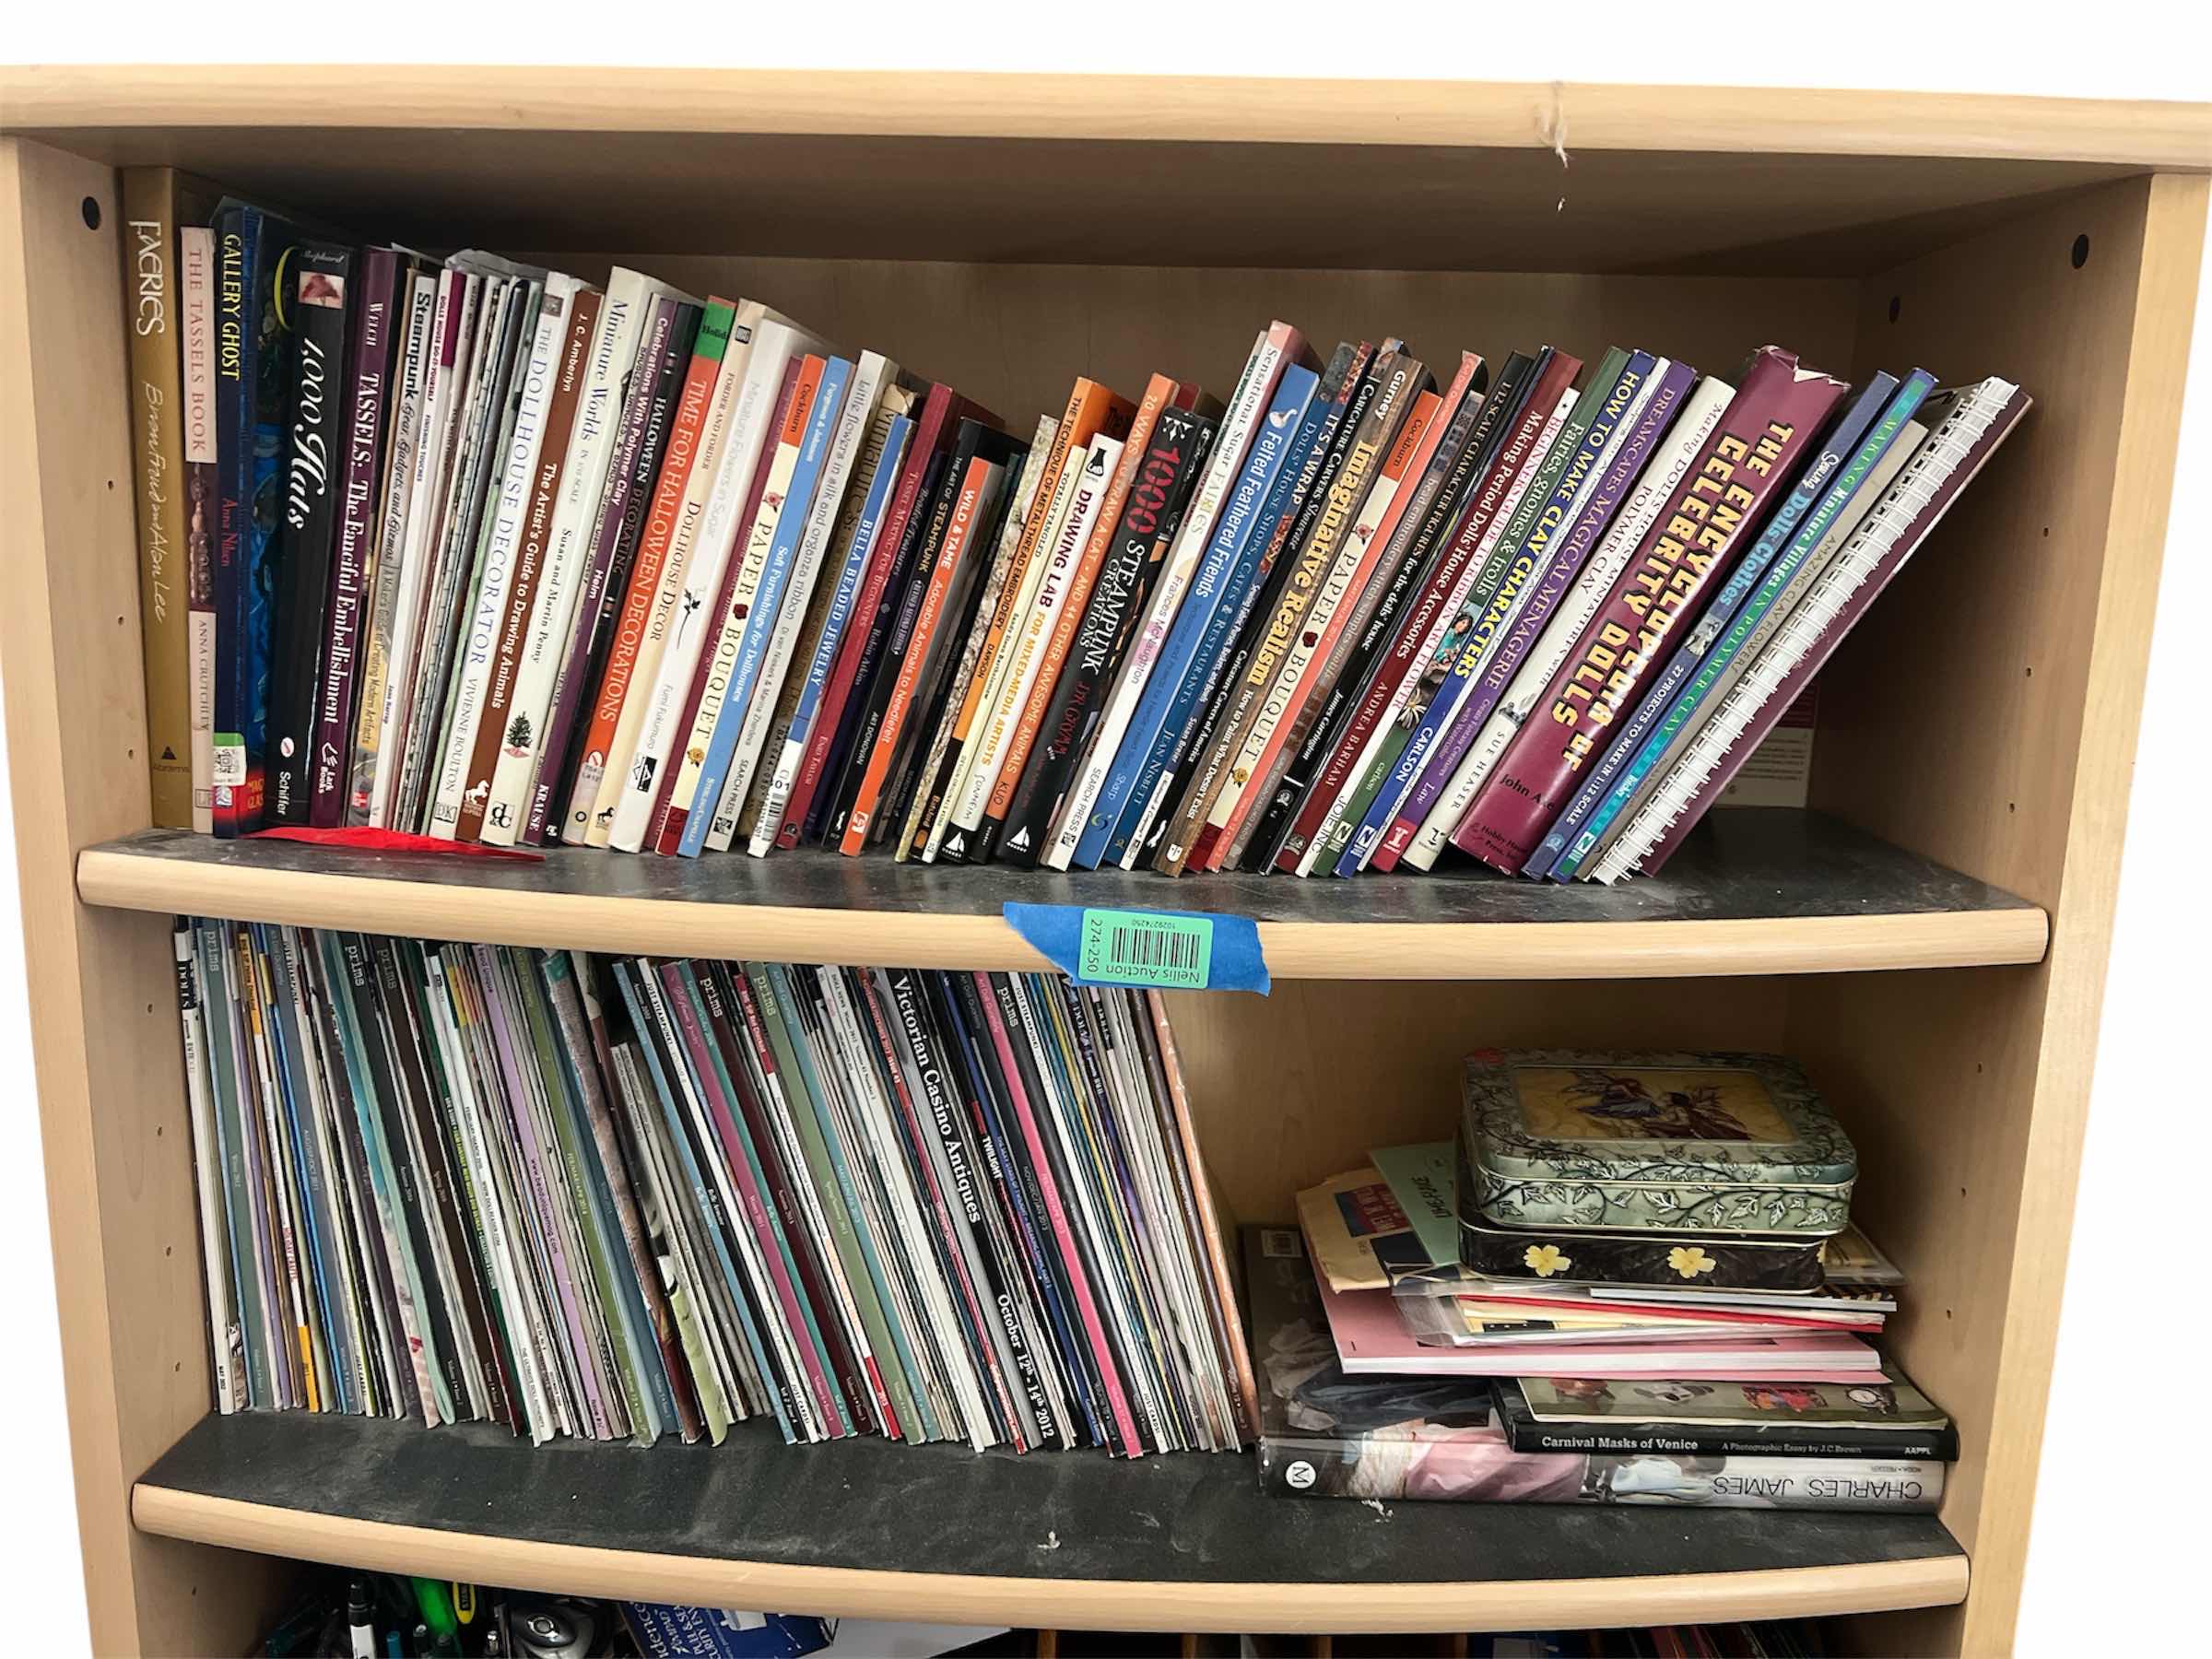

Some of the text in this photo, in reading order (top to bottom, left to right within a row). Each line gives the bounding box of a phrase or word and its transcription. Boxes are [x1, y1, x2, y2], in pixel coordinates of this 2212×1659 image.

[220, 233, 241, 380] GALLERY GHOST
[188, 249, 206, 451] THE TASSELS BOOK
[561, 312, 588, 393] J. C. Amberlyn
[580, 298, 628, 442] Miniature Worlds
[610, 316, 667, 506] Celebrations With Polymer Clay
[1372, 367, 1406, 420] Gurney
[415, 414, 430, 482] FINISHING TOUCHES
[710, 412, 724, 438] AND
[1392, 418, 1423, 468] Cockburn
[1288, 413, 1339, 505] IT'S A WRAP
[221, 497, 237, 529] Anna
[908, 487, 930, 525] Beaded
[1049, 472, 1070, 513] TOTALLY
[1126, 447, 1180, 535] 1000
[1194, 429, 1283, 600] Felted Feathered Friends
[1416, 477, 1438, 506] bead
[1475, 419, 1584, 598] Fairies, gnomes & trolls
[324, 371, 380, 724] TASSELS: The Fanciful Embellishment
[598, 379, 707, 722] TIME FOR HALLOWEEN DECORATIONS
[1033, 512, 1055, 559] TANGLED
[1380, 504, 1423, 570] embroidery
[1394, 408, 1545, 661] Making Period Dolls' House Accessories
[1453, 370, 1641, 679] HOW TO MAKE CLAY CHARACTERS
[1483, 386, 1676, 691] DREAMSCAPES MAGICAL MENAGERIE
[1579, 483, 1653, 594] POLYMER CLAY
[736, 522, 773, 597] PAPER
[890, 526, 916, 577] Treasures
[1244, 435, 1379, 689] Imaginative Realism
[489, 462, 557, 709] The Artist's Guide to Drawing Animals
[808, 518, 873, 687] BELLA BEADED JEWELRY
[1079, 559, 1118, 647] CREATIONS
[1082, 538, 1146, 676] STEAMPUNK
[1364, 571, 1387, 602] stitch
[1551, 435, 1748, 727] CELEBRITY DOLLS
[981, 488, 1093, 766] DRAWING LAB FOR MIXED-MEDIA ARTISTS
[1006, 612, 1019, 633] Sandy
[1339, 600, 1371, 645] samples
[692, 626, 741, 739] BOUQUET
[982, 653, 1004, 700] Bartholomew
[1170, 583, 1260, 763] Sewing Fabric Purses, Baskets, and Bowls Susan Breier
[1241, 552, 1357, 761] PAPER BOUQUET
[1366, 762, 1385, 791] carlson
[1394, 724, 1435, 783] CARLSON
[1452, 731, 1505, 809] SUE HEASER
[276, 771, 291, 814] Schiffer
[1067, 767, 1102, 833] SEARCH PRESS
[1416, 782, 1435, 805] Law
[1500, 773, 1530, 797] John
[204, 930, 219, 973] prims
[346, 945, 365, 987] prims
[1087, 919, 1103, 973] 274-250
[646, 982, 657, 998] JUST
[700, 977, 724, 1018] prims
[756, 975, 776, 1017] prims
[1014, 986, 1024, 1003] JUST
[1106, 964, 1200, 983] Nellis Auction
[997, 985, 1019, 1028] prims
[894, 976, 981, 1224] Victorian Casino Antiques
[982, 1135, 1003, 1181] TWILIGHT
[995, 1293, 1025, 1350] October
[791, 1383, 801, 1399] JUST
[1016, 1352, 1034, 1377] 12th
[1026, 1383, 1044, 1408] 14th
[1142, 1392, 1153, 1408] JUST
[1034, 1407, 1055, 1438] 2012
[1541, 1436, 1699, 1451] Carnival Masks of Venice
[1730, 1442, 1783, 1454] Photographic
[1783, 1444, 1806, 1454] Essay
[1807, 1444, 1819, 1454] by
[1904, 1446, 1932, 1455] AAPPL
[1712, 1476, 1924, 1500] CHARLES JAMES
